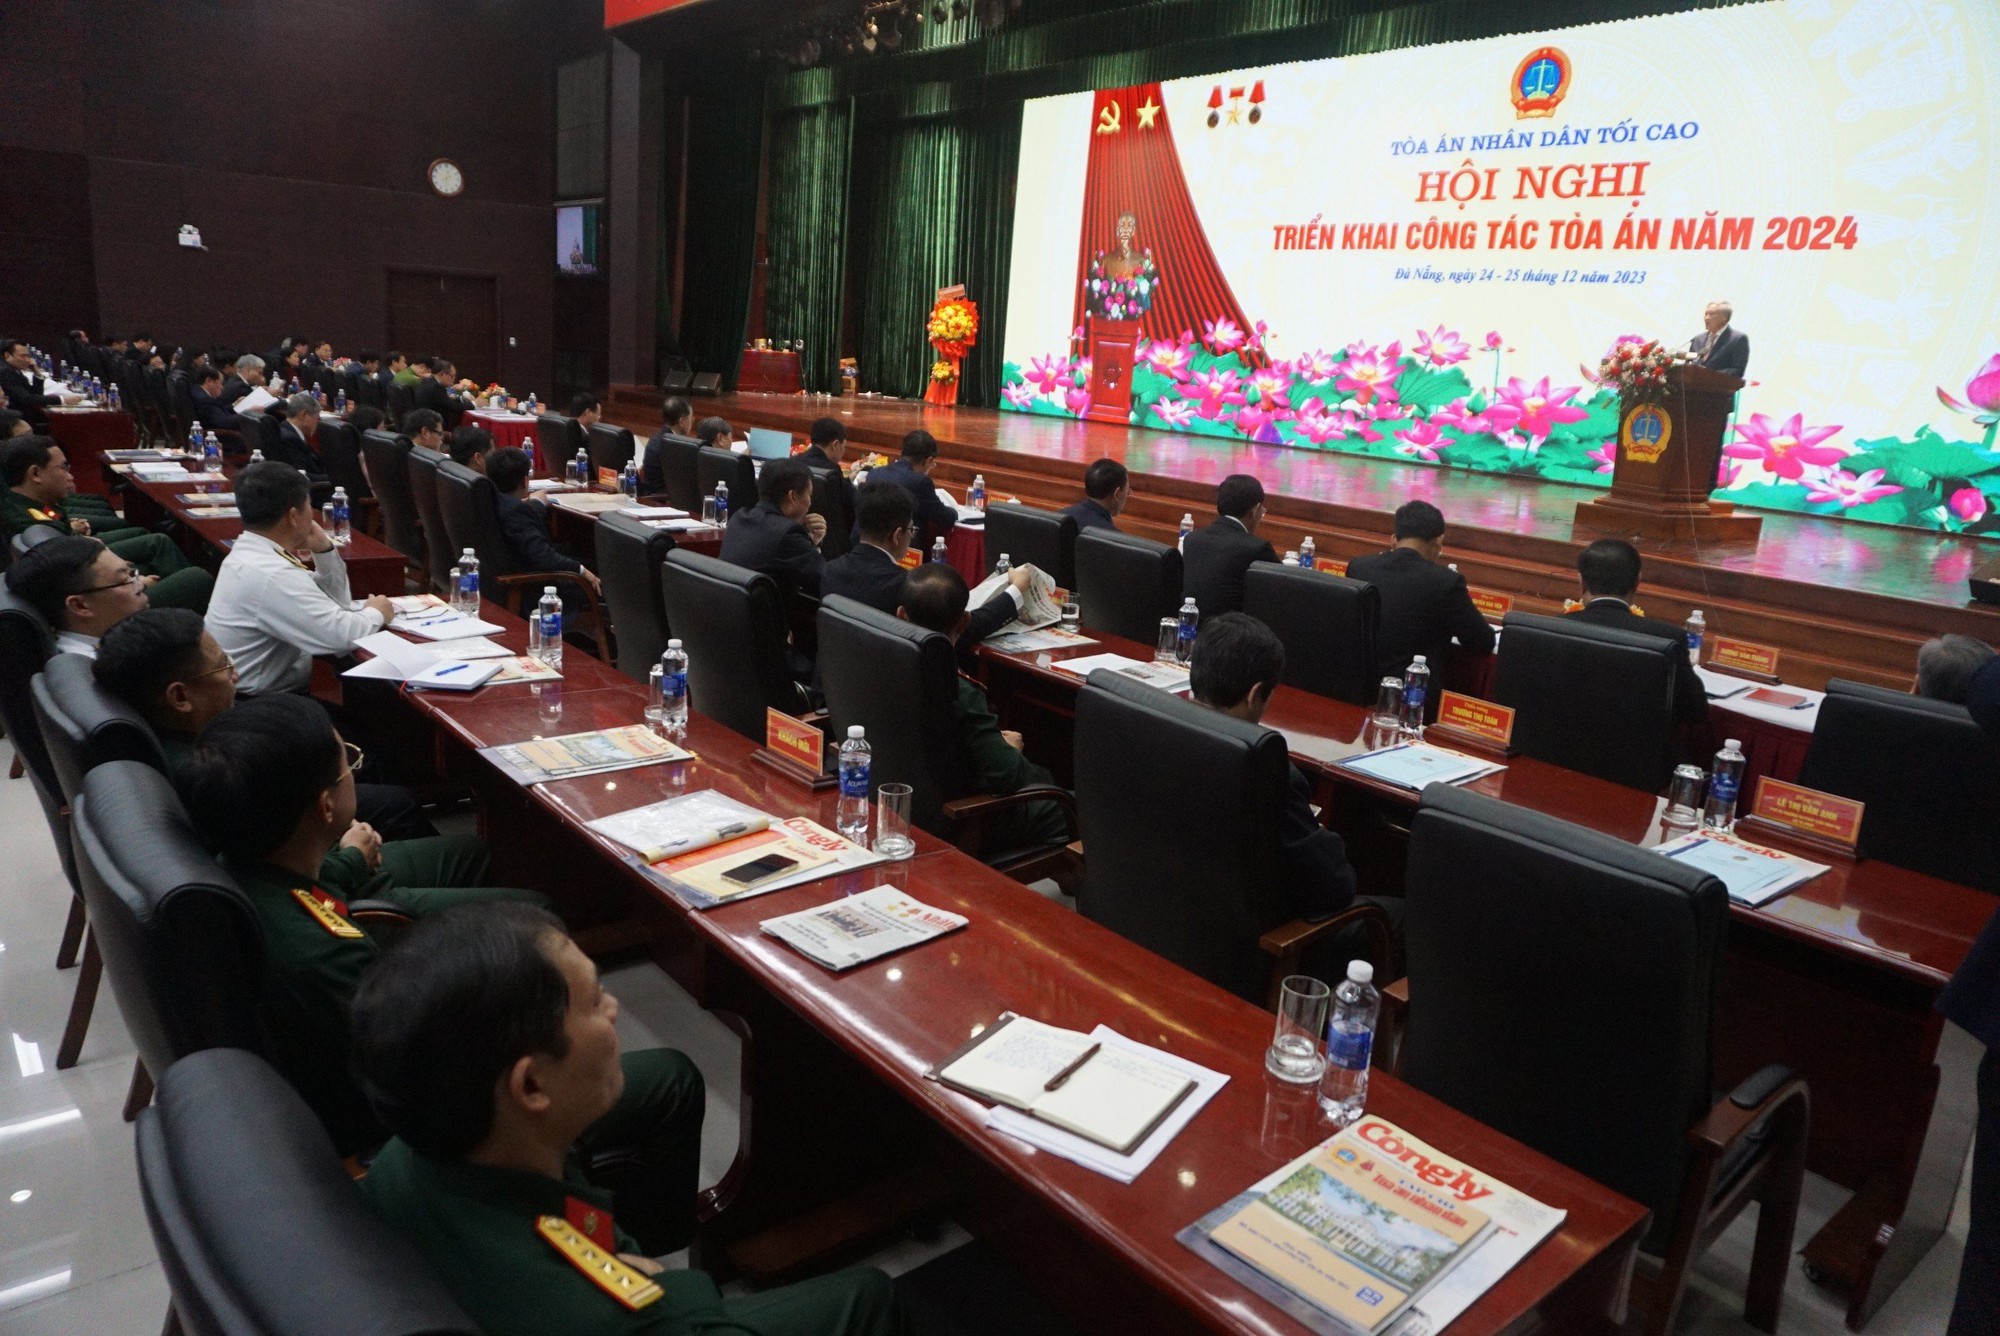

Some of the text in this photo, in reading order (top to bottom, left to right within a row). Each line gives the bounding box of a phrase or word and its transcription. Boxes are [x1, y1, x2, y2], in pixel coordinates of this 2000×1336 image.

[1391, 118, 1699, 155] TÒA ÁN NHÂN DÂN TỐI CAO
[1415, 157, 1650, 210] HỘI NGHỊ
[1273, 210, 1858, 251] TRIỂN KHAI CÔNG TÁC TÒA ÁN NĂM 2024
[1395, 267, 1411, 280] Đà
[1449, 268, 1477, 283] ngày
[1479, 268, 1495, 281] 24
[1505, 268, 1521, 281] 25
[1522, 268, 1559, 285] tháng
[1562, 269, 1578, 282] 12
[1580, 270, 1610, 283] năm
[1613, 270, 1648, 284] 2023
